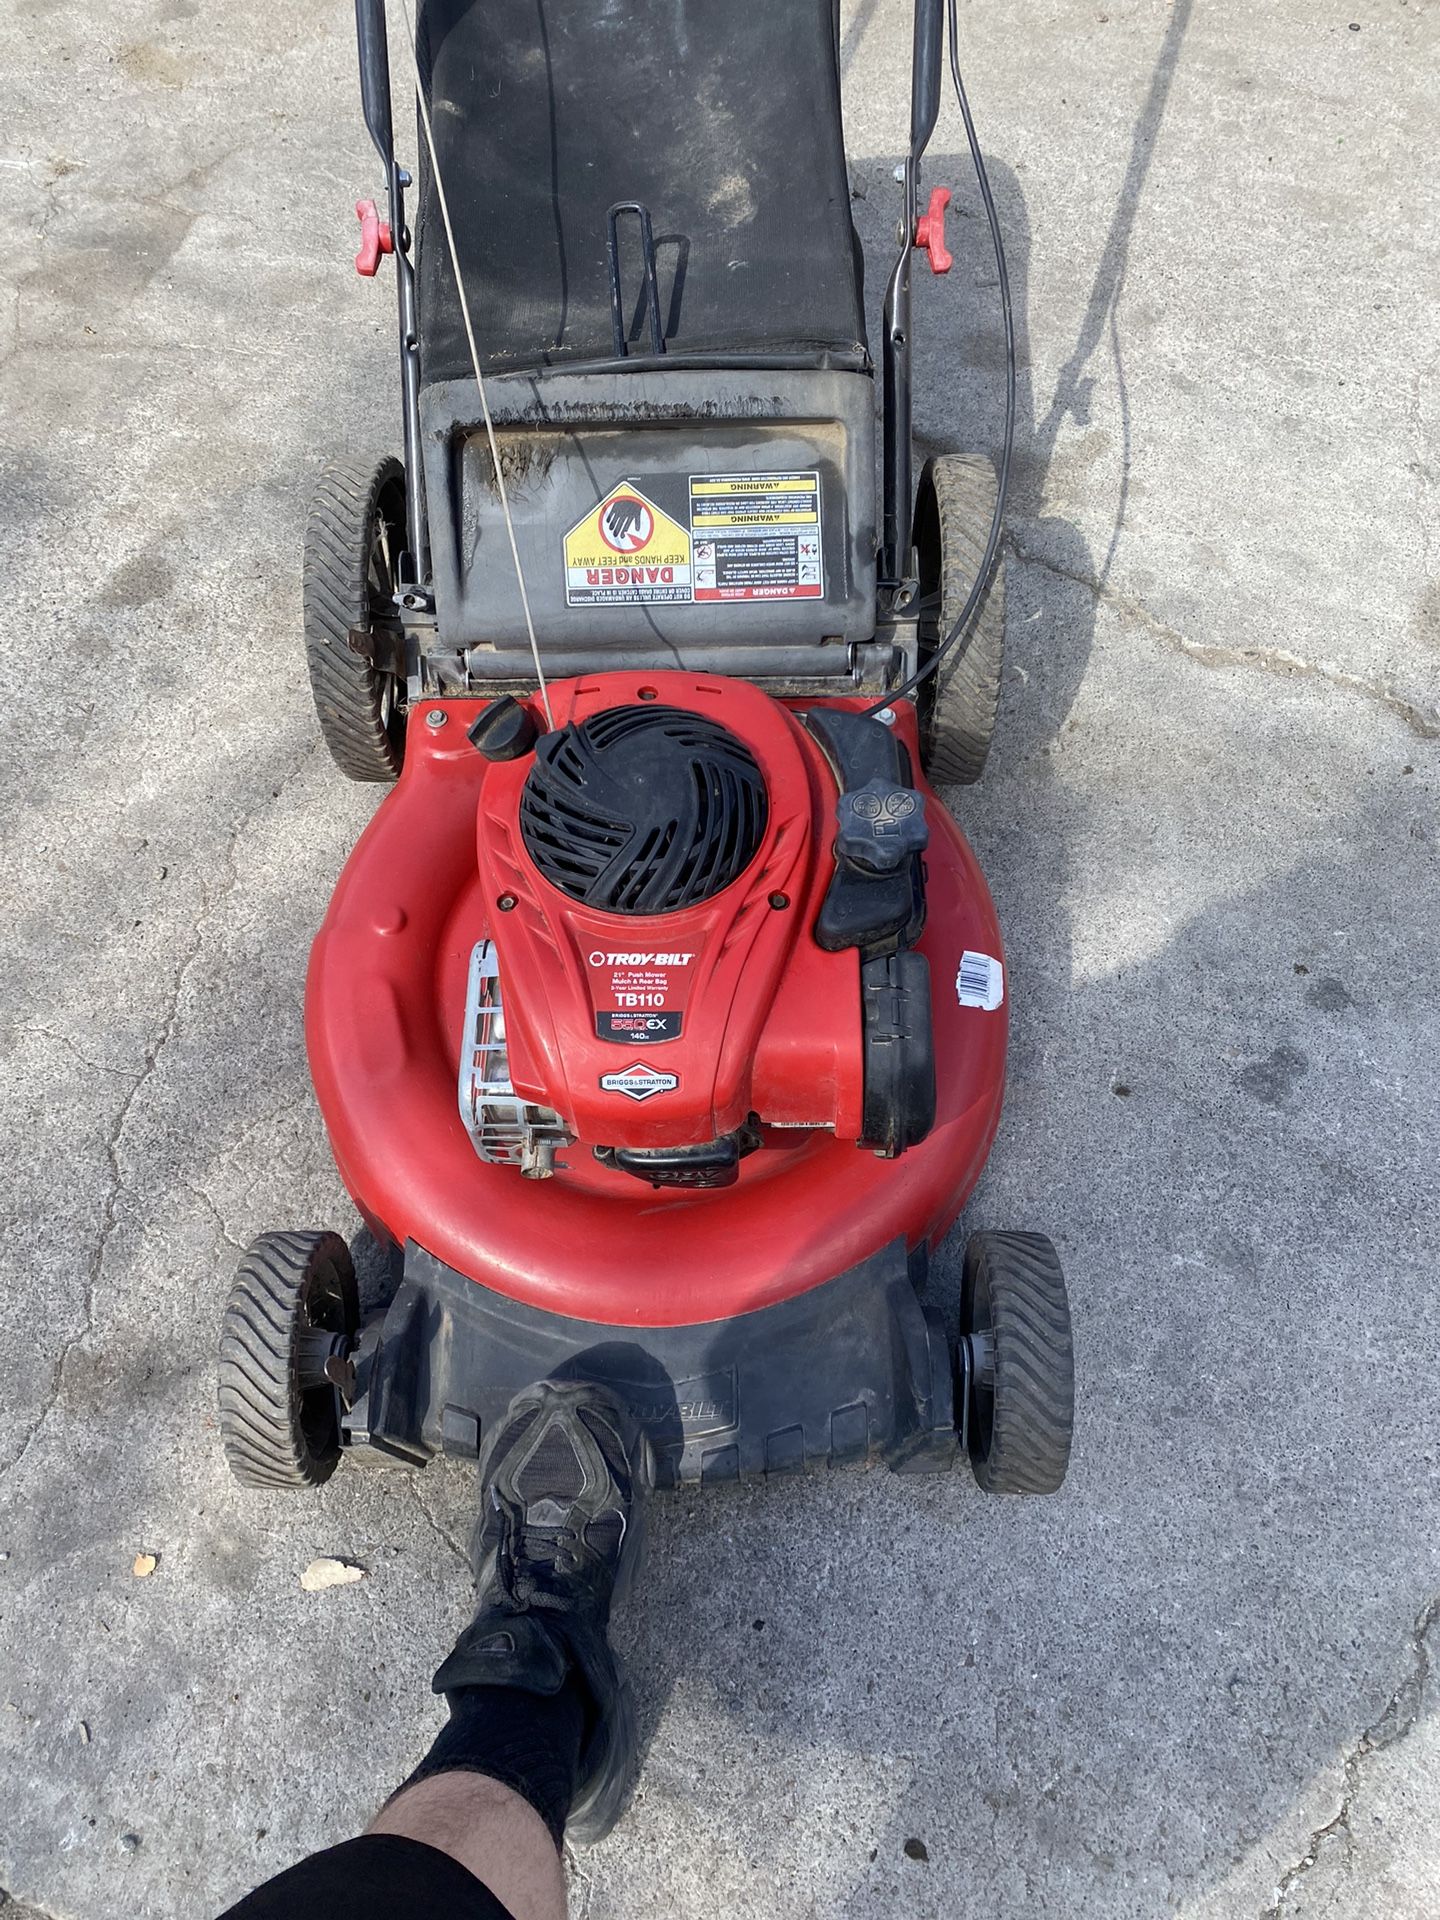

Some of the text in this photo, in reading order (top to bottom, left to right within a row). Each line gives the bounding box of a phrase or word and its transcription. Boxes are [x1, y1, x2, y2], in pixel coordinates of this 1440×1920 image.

[572, 554, 684, 566] KEEP HANDS and FEET AWAY
[586, 568, 674, 584] DANGER
[606, 953, 692, 966] TROY-BILT
[614, 993, 664, 1006] TB110
